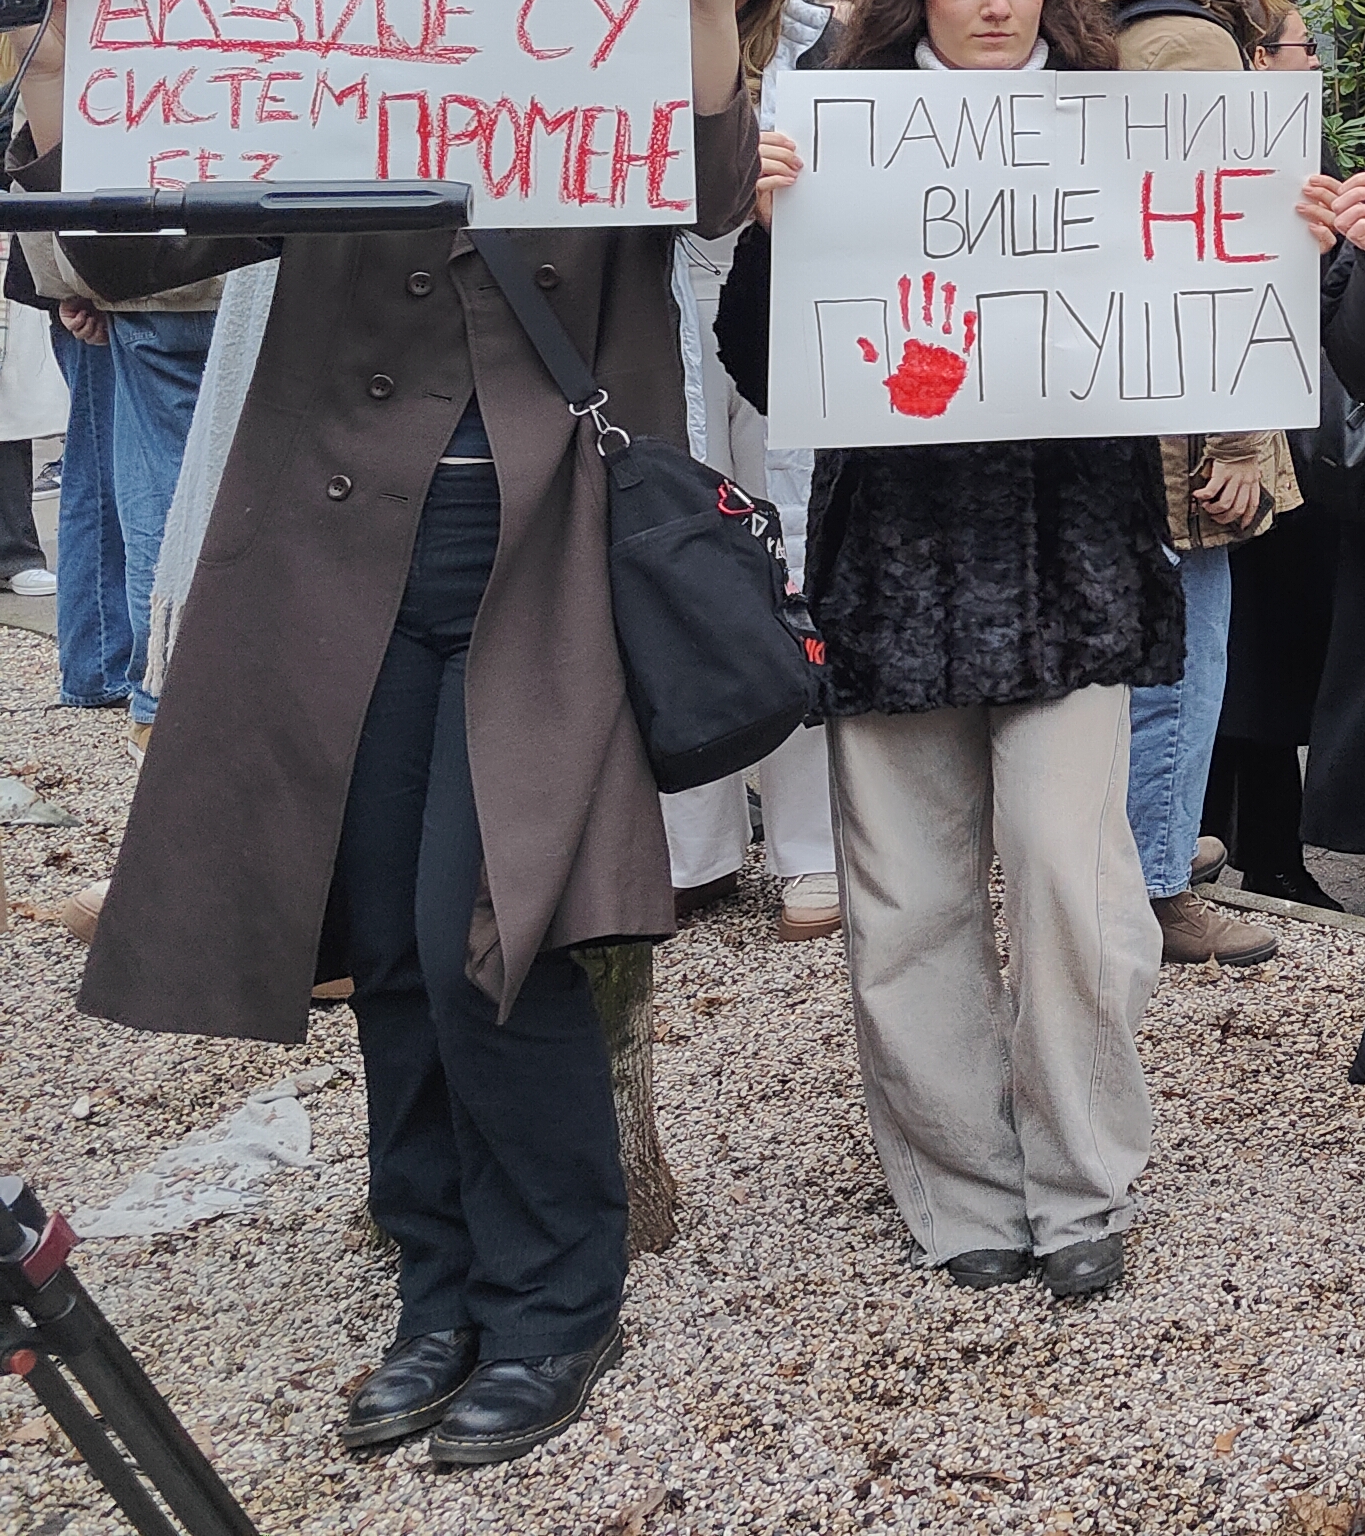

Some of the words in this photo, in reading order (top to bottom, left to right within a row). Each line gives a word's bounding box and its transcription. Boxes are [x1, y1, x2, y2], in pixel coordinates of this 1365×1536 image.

[78, 66, 371, 132] СИСТЕМ
[375, 91, 692, 212] ПРОМЕНЕ
[813, 91, 1310, 172] ПАМЕТНИЈИ
[922, 185, 1101, 259] ВИШЕ
[1140, 167, 1279, 263] НЕ
